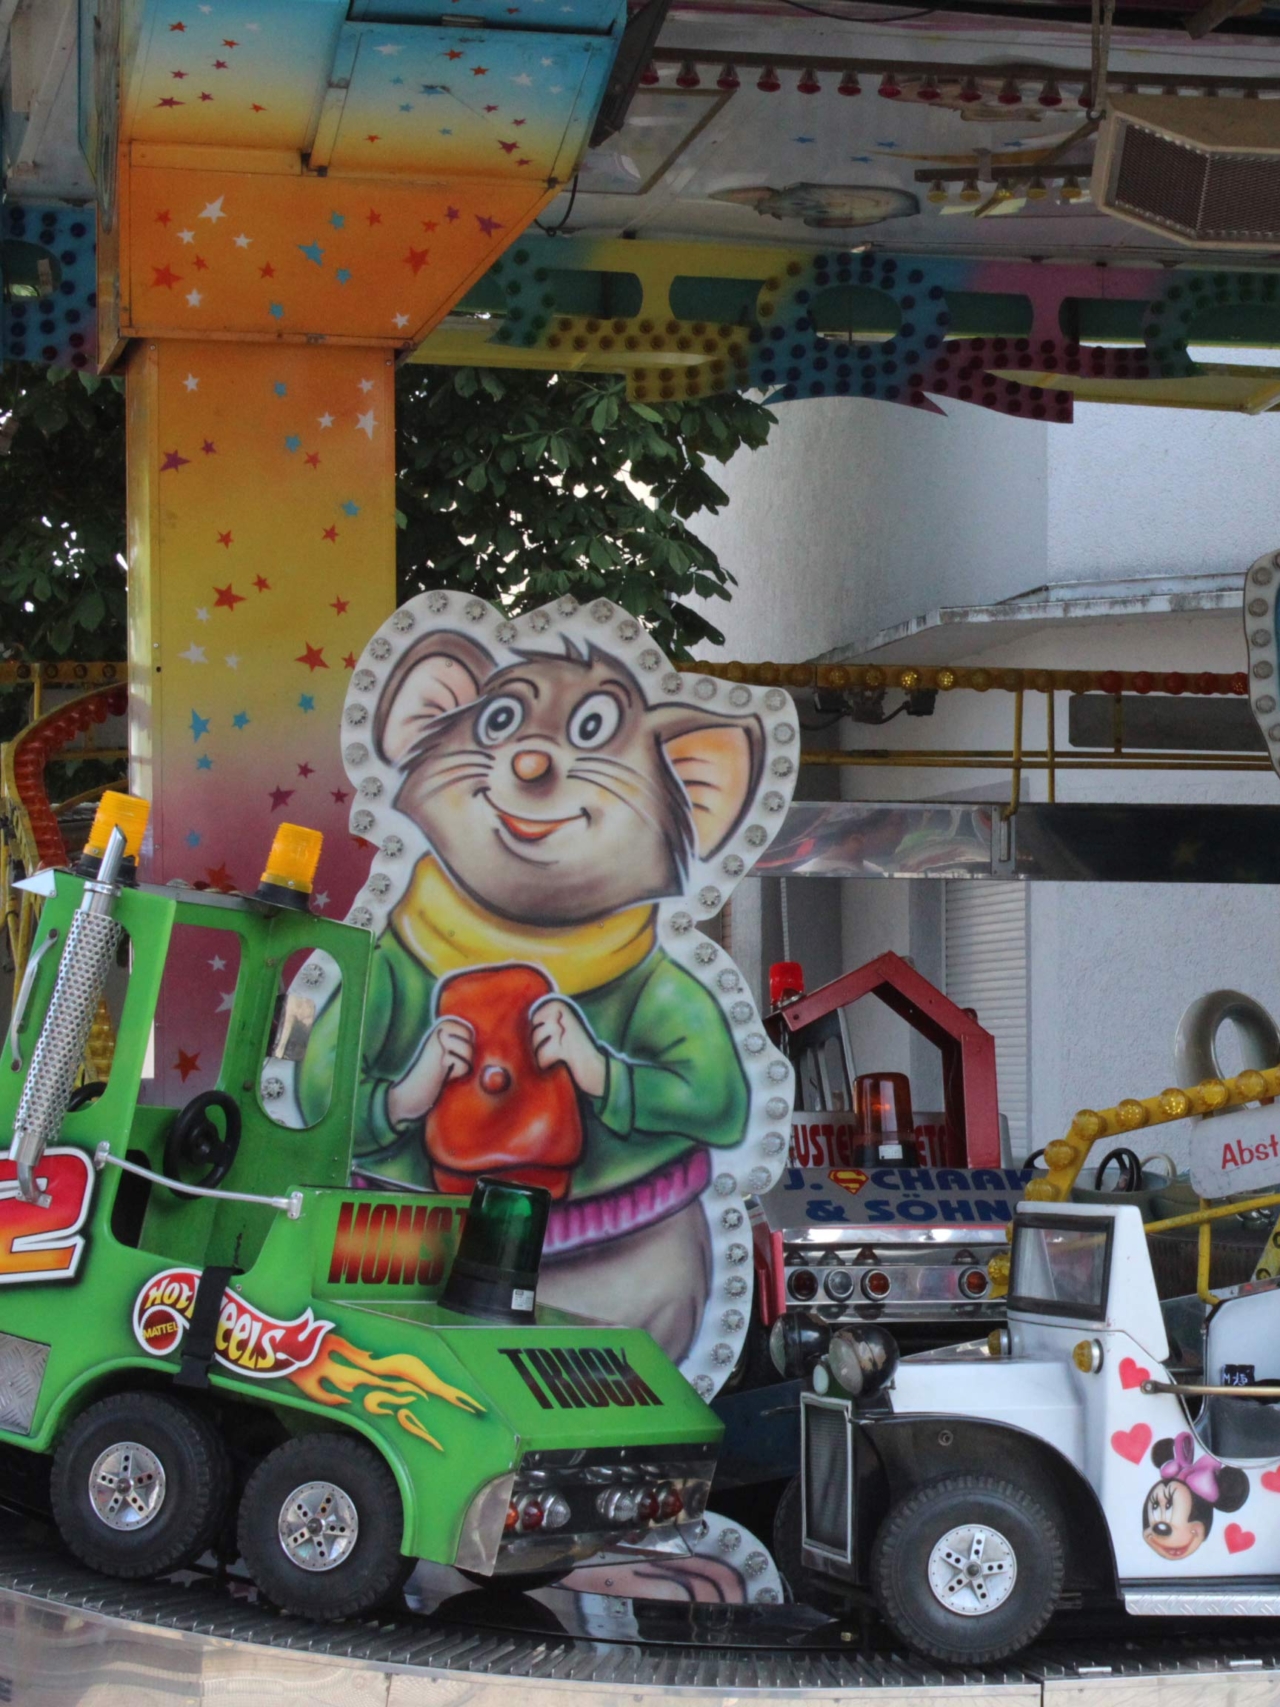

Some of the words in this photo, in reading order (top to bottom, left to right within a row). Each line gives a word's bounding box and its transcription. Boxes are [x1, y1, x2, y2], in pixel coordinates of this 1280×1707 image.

[805, 1200, 852, 1222] &
[142, 1321, 180, 1341] MATTEL
[497, 1347, 664, 1410] TRUCK
